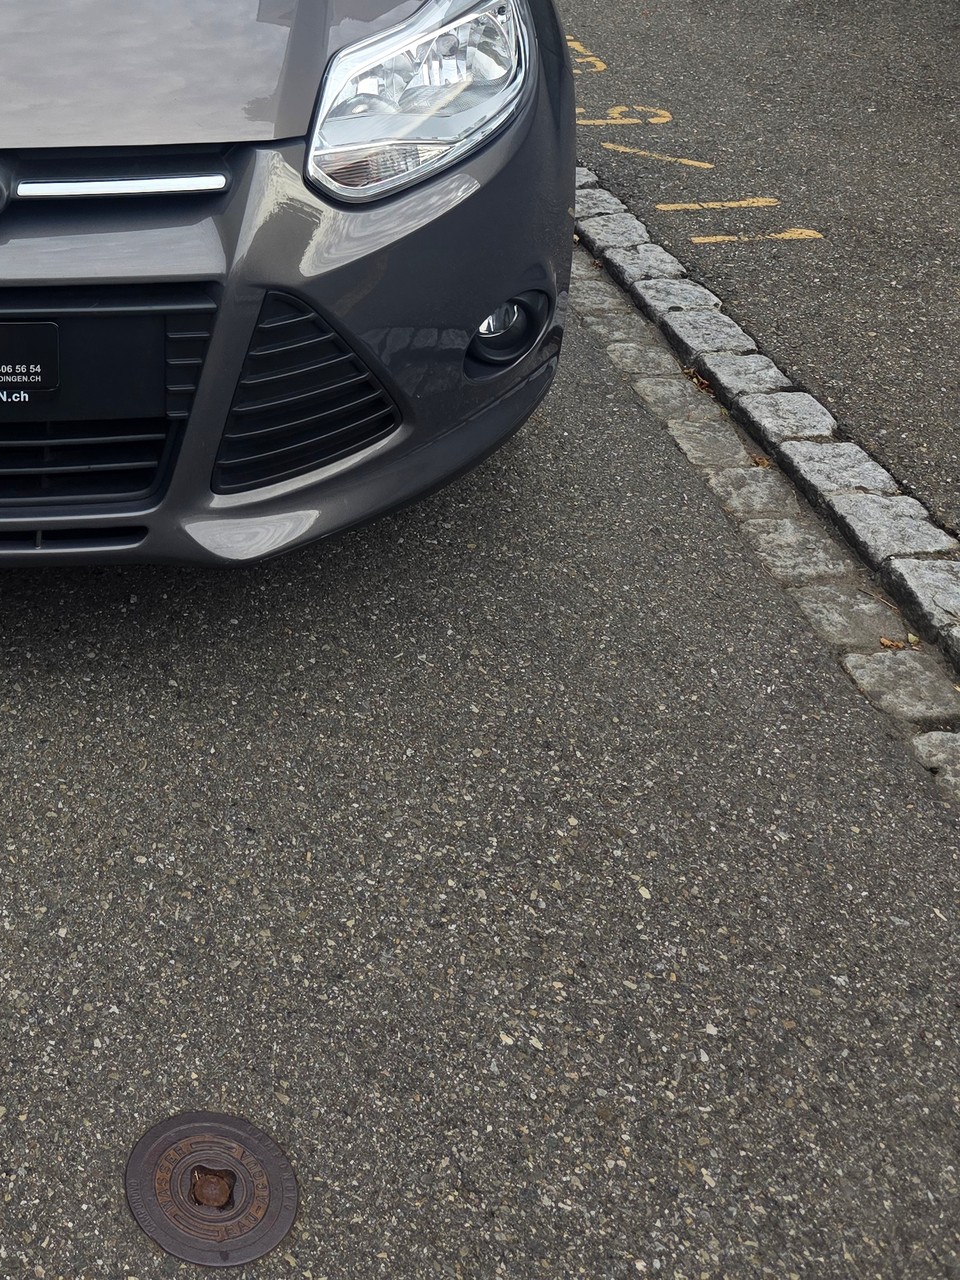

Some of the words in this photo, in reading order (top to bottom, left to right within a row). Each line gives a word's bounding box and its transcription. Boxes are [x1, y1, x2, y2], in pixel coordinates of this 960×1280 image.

[15, 365, 27, 373] 56
[29, 365, 42, 373] 54
[156, 1145, 186, 1217] WASSER
